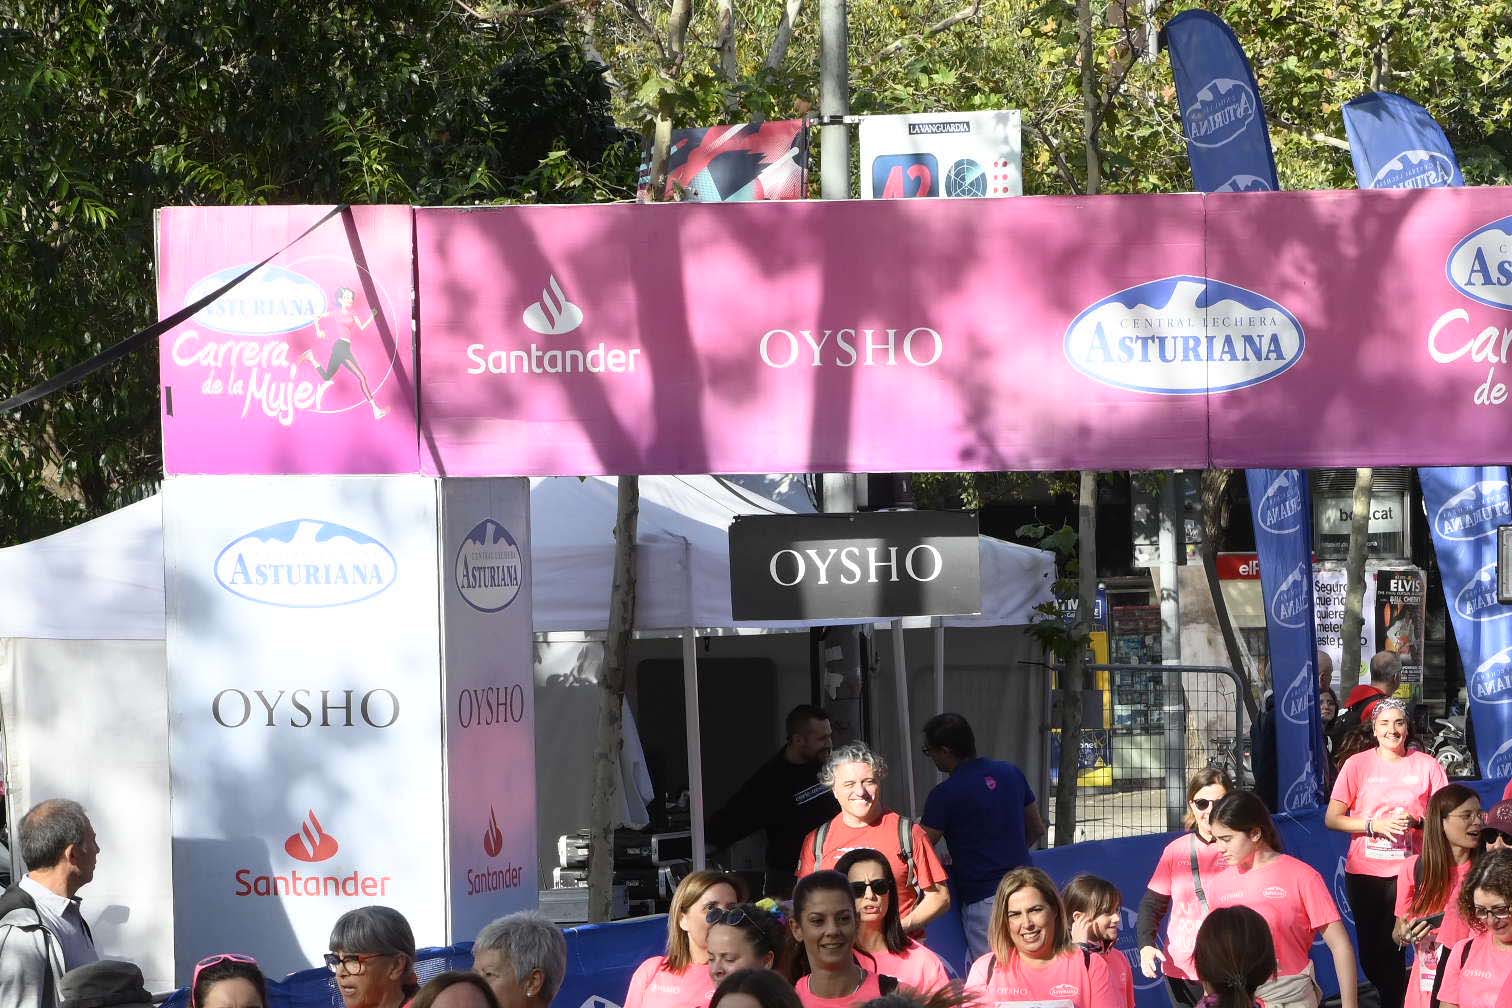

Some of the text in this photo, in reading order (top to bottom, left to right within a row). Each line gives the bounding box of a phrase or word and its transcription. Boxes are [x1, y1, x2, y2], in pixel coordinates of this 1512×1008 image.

[1120, 315, 1280, 330] CENTRAL LECHERA
[172, 330, 292, 368] Carrera
[467, 344, 641, 375] Santander
[759, 326, 943, 369] OYSHO
[1087, 320, 1287, 364] ASTURIANA
[202, 365, 336, 426] de la Mujer
[1473, 366, 1509, 406] de
[228, 552, 384, 586] ASTURIANA
[461, 552, 520, 589] ASTURIANA
[769, 545, 943, 586] OYSHO
[1316, 597, 1332, 608] que
[1390, 579, 1420, 592] ELVIS
[211, 688, 400, 728] OYSHO
[458, 683, 525, 729] OYSHO
[235, 869, 391, 897] Santander
[466, 862, 523, 896] Santander
